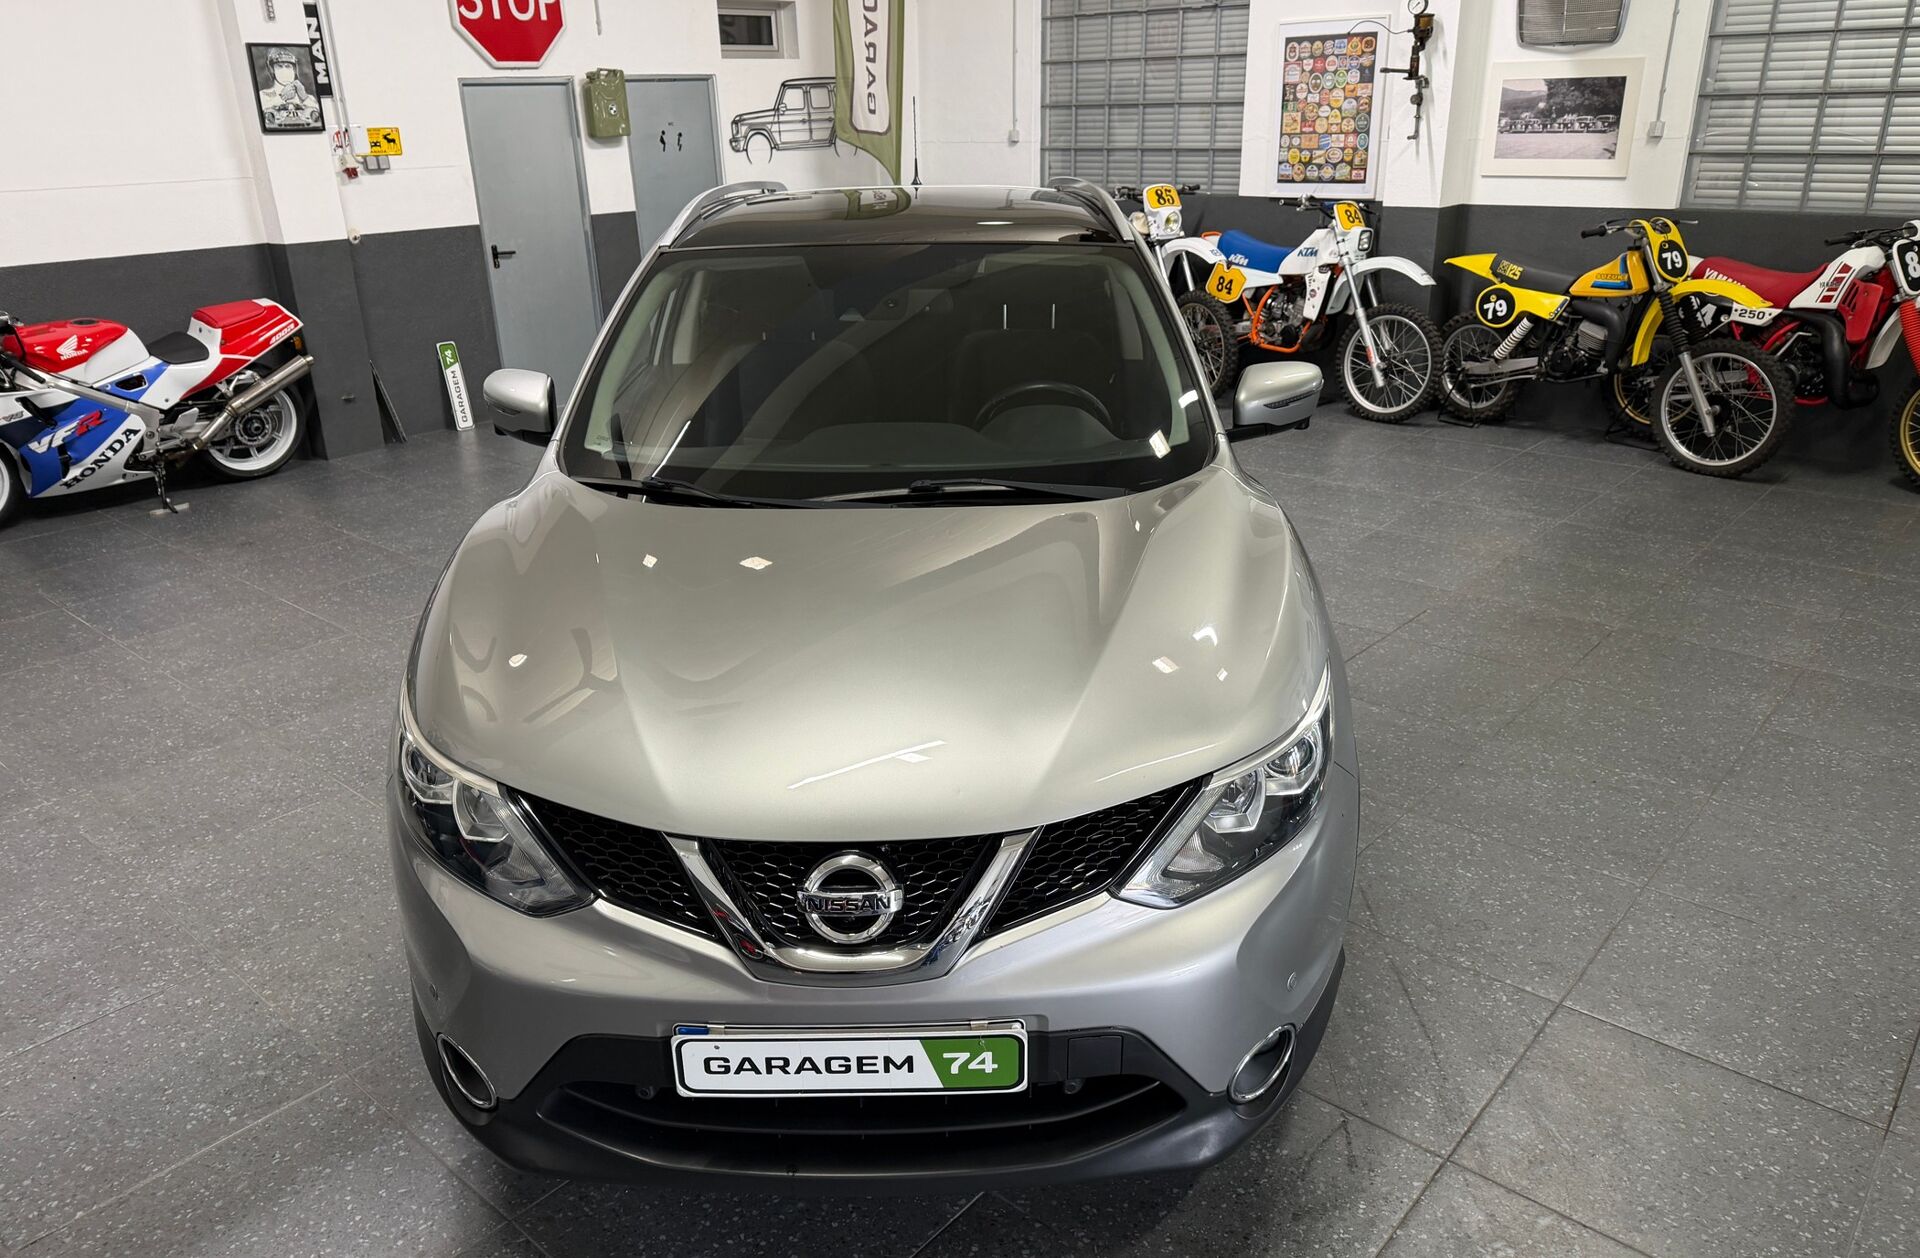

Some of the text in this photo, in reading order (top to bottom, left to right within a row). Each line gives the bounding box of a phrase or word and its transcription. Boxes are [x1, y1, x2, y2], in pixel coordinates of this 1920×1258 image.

[306, 17, 329, 84] MAN
[1155, 188, 1175, 206] 85
[1344, 209, 1362, 224] 84
[1228, 253, 1249, 266] KTM
[1297, 247, 1318, 257] KTM
[1662, 250, 1682, 270] 79
[1216, 276, 1233, 295] 84
[1483, 300, 1507, 320] 79
[1738, 309, 1765, 320] 250
[60, 348, 89, 360] HONDA
[444, 349, 468, 422] GARAGEM 74
[26, 410, 104, 454] VFR
[59, 427, 142, 490] HONDA
[805, 895, 891, 913] NISSAN
[703, 1051, 999, 1076] GARAGEM 74
